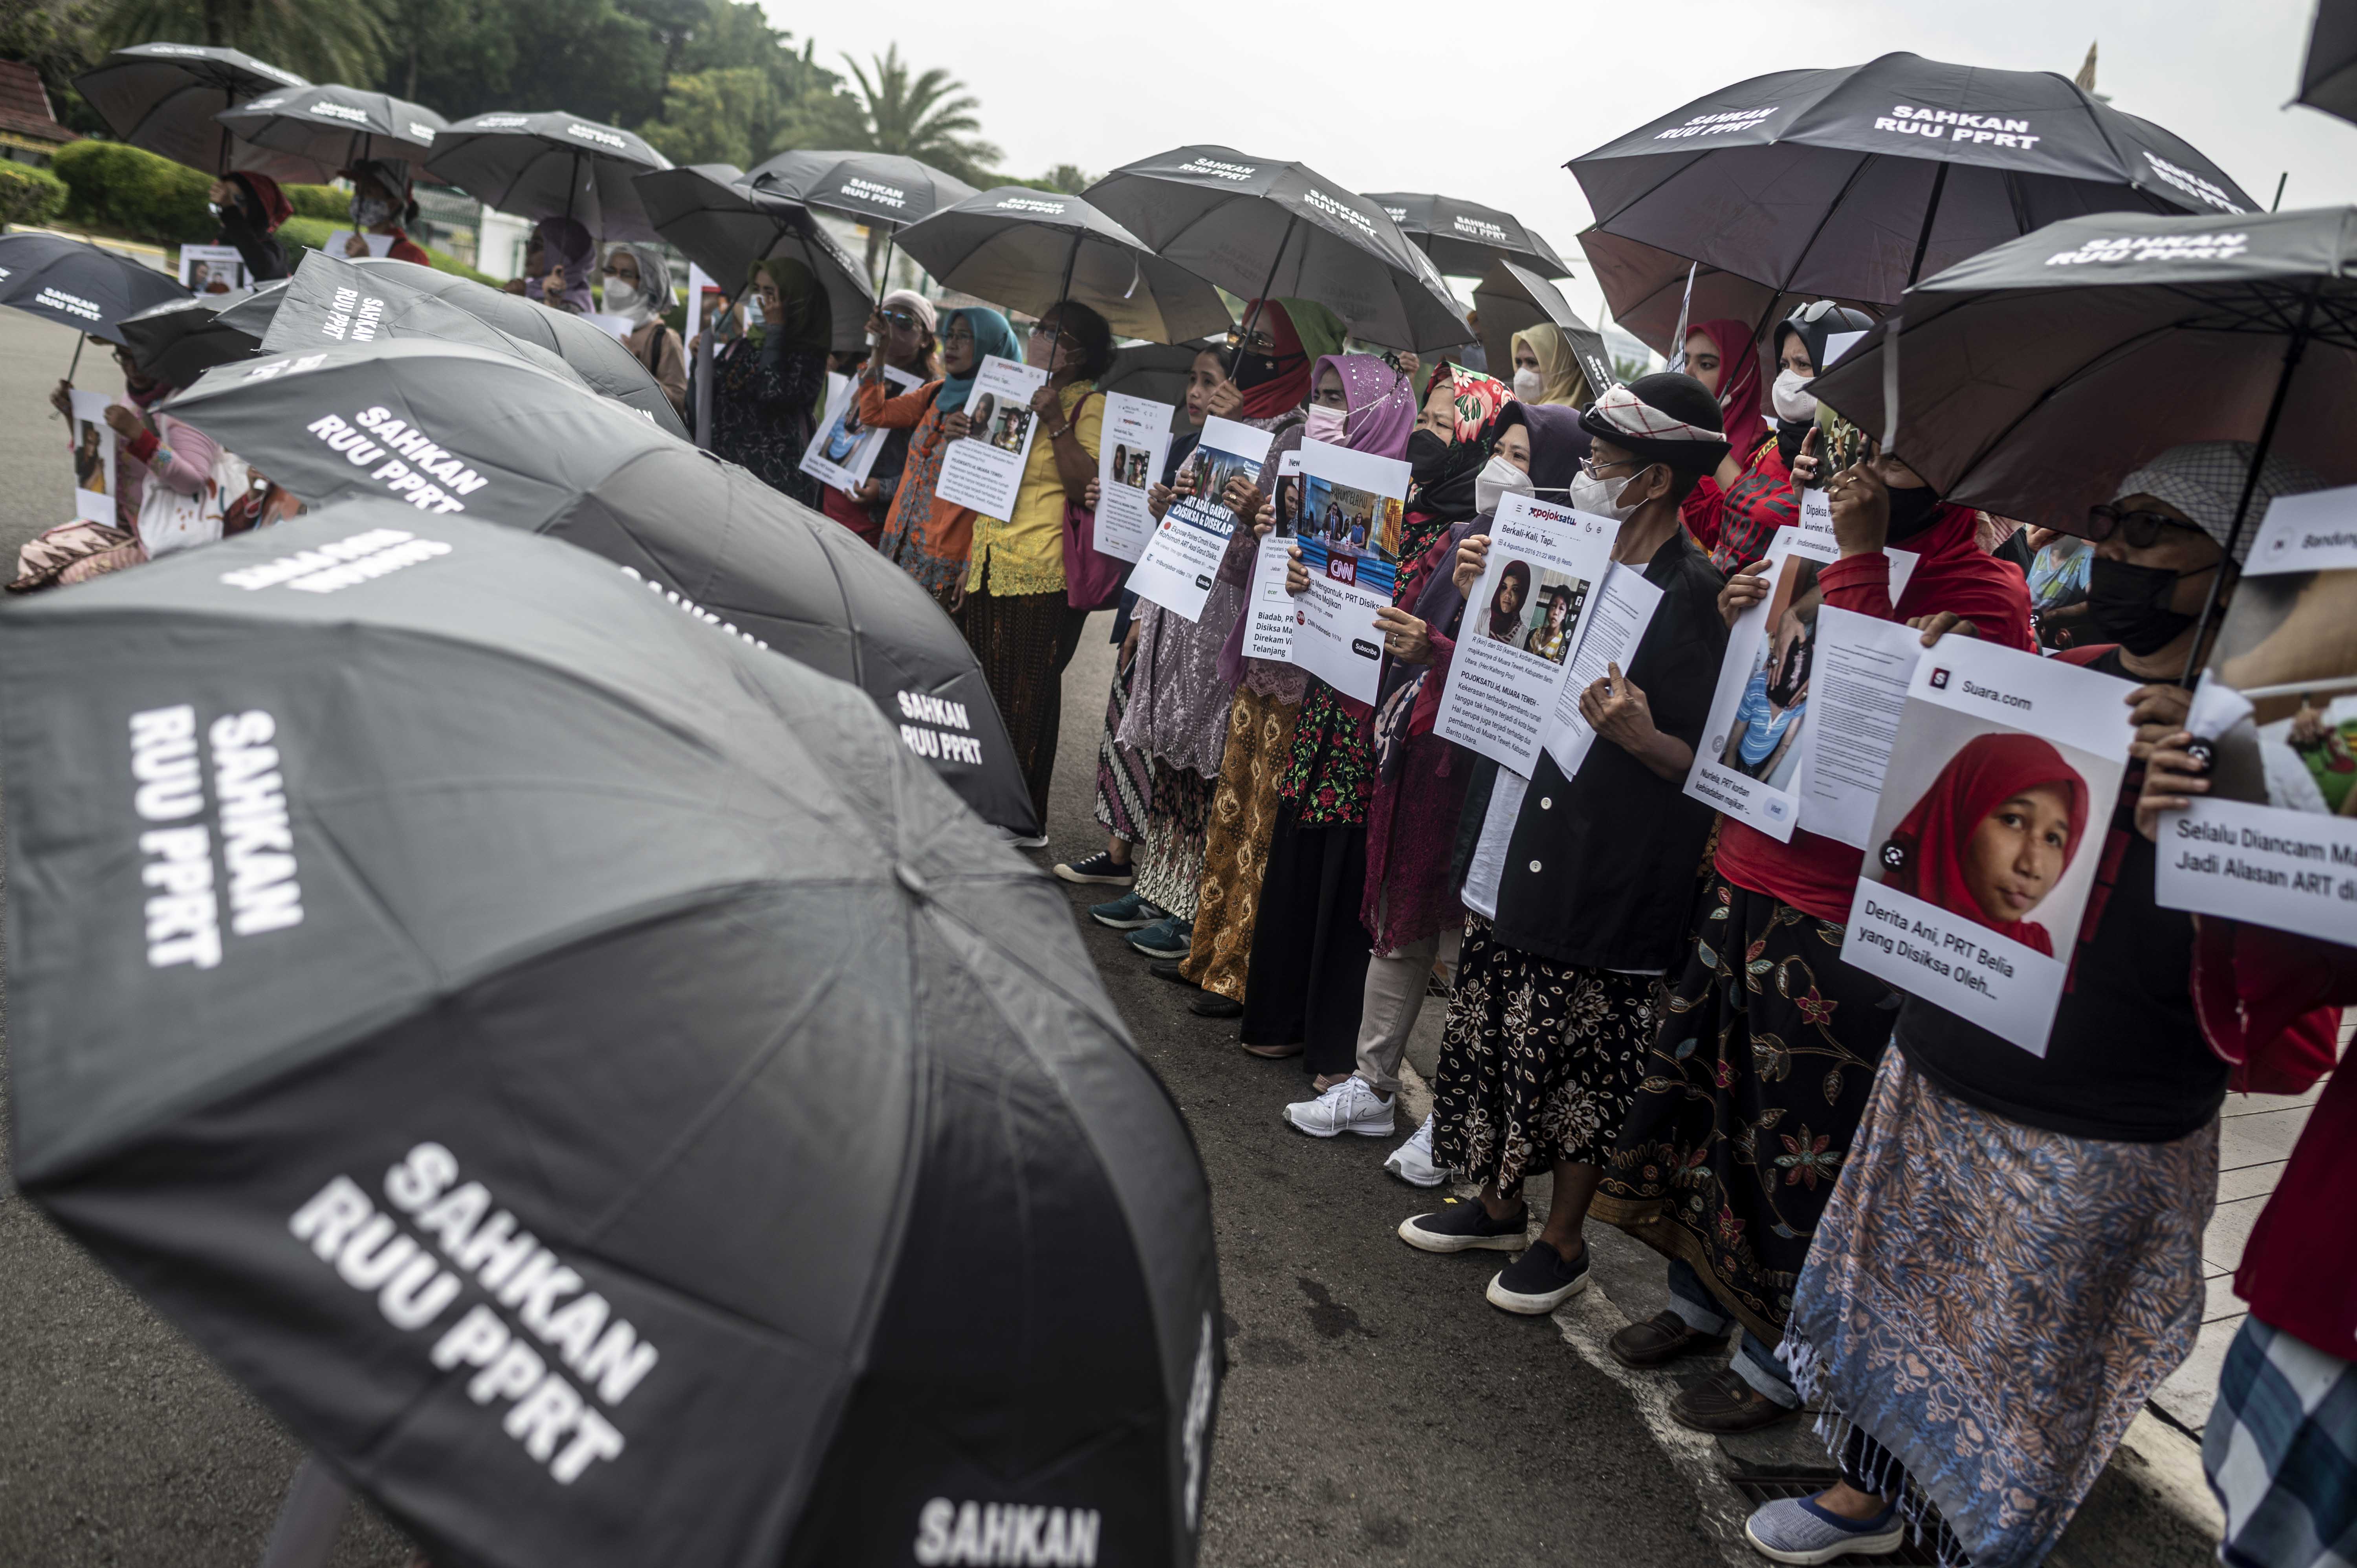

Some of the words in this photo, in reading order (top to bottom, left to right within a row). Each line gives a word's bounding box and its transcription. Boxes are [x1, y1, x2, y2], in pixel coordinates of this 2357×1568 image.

[1653, 123, 1703, 140] RUU
[1701, 117, 1766, 136] PPRT
[1685, 106, 1780, 126] SAHKAN
[1892, 105, 2029, 133] SAHKAN
[1874, 117, 1950, 139] RUU
[1952, 128, 2040, 150] PPRT
[1178, 163, 1212, 174] RUU
[1210, 170, 1251, 181] PPRT
[1195, 158, 1256, 174] SAHKAN
[841, 185, 869, 199] RUU
[872, 193, 906, 208] PPRT
[850, 178, 903, 199] SAHKAN
[1008, 198, 1064, 209] SAHKAN
[1028, 206, 1065, 214] PPRT
[1304, 194, 1336, 215] RUU
[1340, 211, 1376, 237] PPRT
[1310, 189, 1370, 226] SAHKAN
[1454, 222, 1476, 234] RUU
[1479, 228, 1506, 240] PPRT
[1457, 216, 1500, 232] SAHKAN
[2045, 248, 2133, 266] RUU
[2133, 245, 2247, 261] PPRT
[2081, 234, 2249, 252] SAHKAN
[35, 293, 64, 310] RUU
[66, 304, 103, 321] PPRT
[44, 287, 100, 312] SAHKAN
[333, 286, 358, 312] RUU
[322, 310, 350, 340] PPRT
[352, 298, 384, 342] SAHKAN
[307, 414, 386, 466] RUU
[371, 459, 465, 514] PPRT
[356, 406, 488, 496] SAHKAN
[1172, 504, 1199, 524] DISIKSA
[1199, 515, 1204, 526] &
[1204, 515, 1233, 535] DISEKAP
[1184, 495, 1197, 509] ART
[1195, 499, 1210, 513] ASAL
[1210, 504, 1233, 521] GARUT
[1535, 509, 1576, 526] pojoksatu
[1807, 504, 1826, 517] Dipaksa
[1158, 530, 1180, 544] Rohimah
[1171, 526, 1187, 537] Ekpose
[1188, 532, 1197, 542] Polres
[1210, 541, 1220, 551] Kasus
[1502, 525, 1538, 542] Berkali-Kali,
[1541, 535, 1556, 547] Tapi...
[1507, 542, 1524, 552] Agustus
[1536, 550, 1547, 559] 21:22
[1156, 559, 1176, 572] tribunjabar
[1331, 559, 1354, 581] CNN
[1198, 578, 1210, 587] Subscribe
[1316, 578, 1343, 601] Mengantuk,
[1345, 593, 1358, 604] PRT
[1322, 594, 1341, 610] Majikan
[1256, 623, 1280, 632] Disiksa
[1258, 612, 1283, 623] Biadab,
[1316, 623, 1331, 637] Indonesia
[1253, 644, 1286, 657] Telanjang
[1254, 634, 1283, 644] Direkam
[1356, 643, 1377, 656] Subscribe
[1468, 647, 1492, 660] majikannya
[1497, 657, 1510, 667] Muara
[1511, 662, 1524, 672] Teweh,
[1525, 668, 1546, 680] Kabupaten
[1477, 638, 1487, 647] (kiri)
[1503, 647, 1518, 658] (kanan),
[1519, 653, 1532, 662] korban
[1533, 659, 1552, 671] penyiksaan
[1465, 657, 1477, 666] Utara.
[1479, 662, 1505, 678] (Her/Kalteng
[1505, 672, 1515, 681] Pos)
[1461, 671, 1501, 692] POJOKSATU.id,
[1502, 687, 1519, 700] MUARA
[1521, 694, 1536, 707] TEWEH
[1962, 680, 2032, 711] Suara.com
[898, 690, 970, 730] SAHKAN
[1455, 694, 1473, 706] tangga
[1483, 704, 1497, 716] hanya
[1499, 711, 1513, 721] terjadi
[1518, 721, 1527, 729] kota
[1458, 682, 1485, 698] Kekerasan
[1486, 693, 1507, 707] terhadap
[1508, 703, 1529, 717] pembantu
[1529, 713, 1541, 723] rumah
[1446, 727, 1461, 738] Barito
[1463, 733, 1477, 745] Utara.
[1452, 705, 1461, 713] Hal
[1462, 709, 1480, 721] serupa
[1480, 717, 1491, 726] juga
[1492, 722, 1506, 732] terjadi
[1507, 728, 1524, 742] terhadap
[899, 724, 940, 758] RUU
[941, 731, 982, 765] PPRT
[1448, 717, 1475, 731] pembantu
[1482, 729, 1496, 741] Muara
[1497, 736, 1511, 748] Teweh,
[1512, 744, 1530, 758] Kabupaten
[129, 703, 203, 822] RUU
[1700, 768, 1720, 785] Nurlela,
[1721, 778, 1733, 789] PRT
[1731, 782, 1750, 797] korban
[1695, 781, 1724, 801] kebiadaban
[1725, 797, 1744, 811] majikan
[1771, 804, 1782, 814] Visit
[210, 709, 304, 935] SAHKAN
[2177, 818, 2237, 846] Selalu
[2241, 828, 2326, 861] Diancam
[2175, 851, 2220, 874] Jadi
[2223, 858, 2288, 887] Alasan
[2293, 871, 2334, 898] ART
[138, 825, 222, 969] PPRT
[1865, 900, 1908, 931] Derita
[1911, 921, 1939, 946] Ani,
[1943, 933, 1977, 958] PRT
[1976, 949, 2014, 978] Belia
[1858, 926, 1894, 954] yang
[1897, 940, 1950, 976] Disiksa
[1954, 966, 1997, 1000] Oleh...
[384, 1141, 659, 1405] SAHKAN
[288, 1174, 461, 1332] RUU
[431, 1303, 624, 1486] PPRT
[913, 1497, 1100, 1568] SAHKAN
